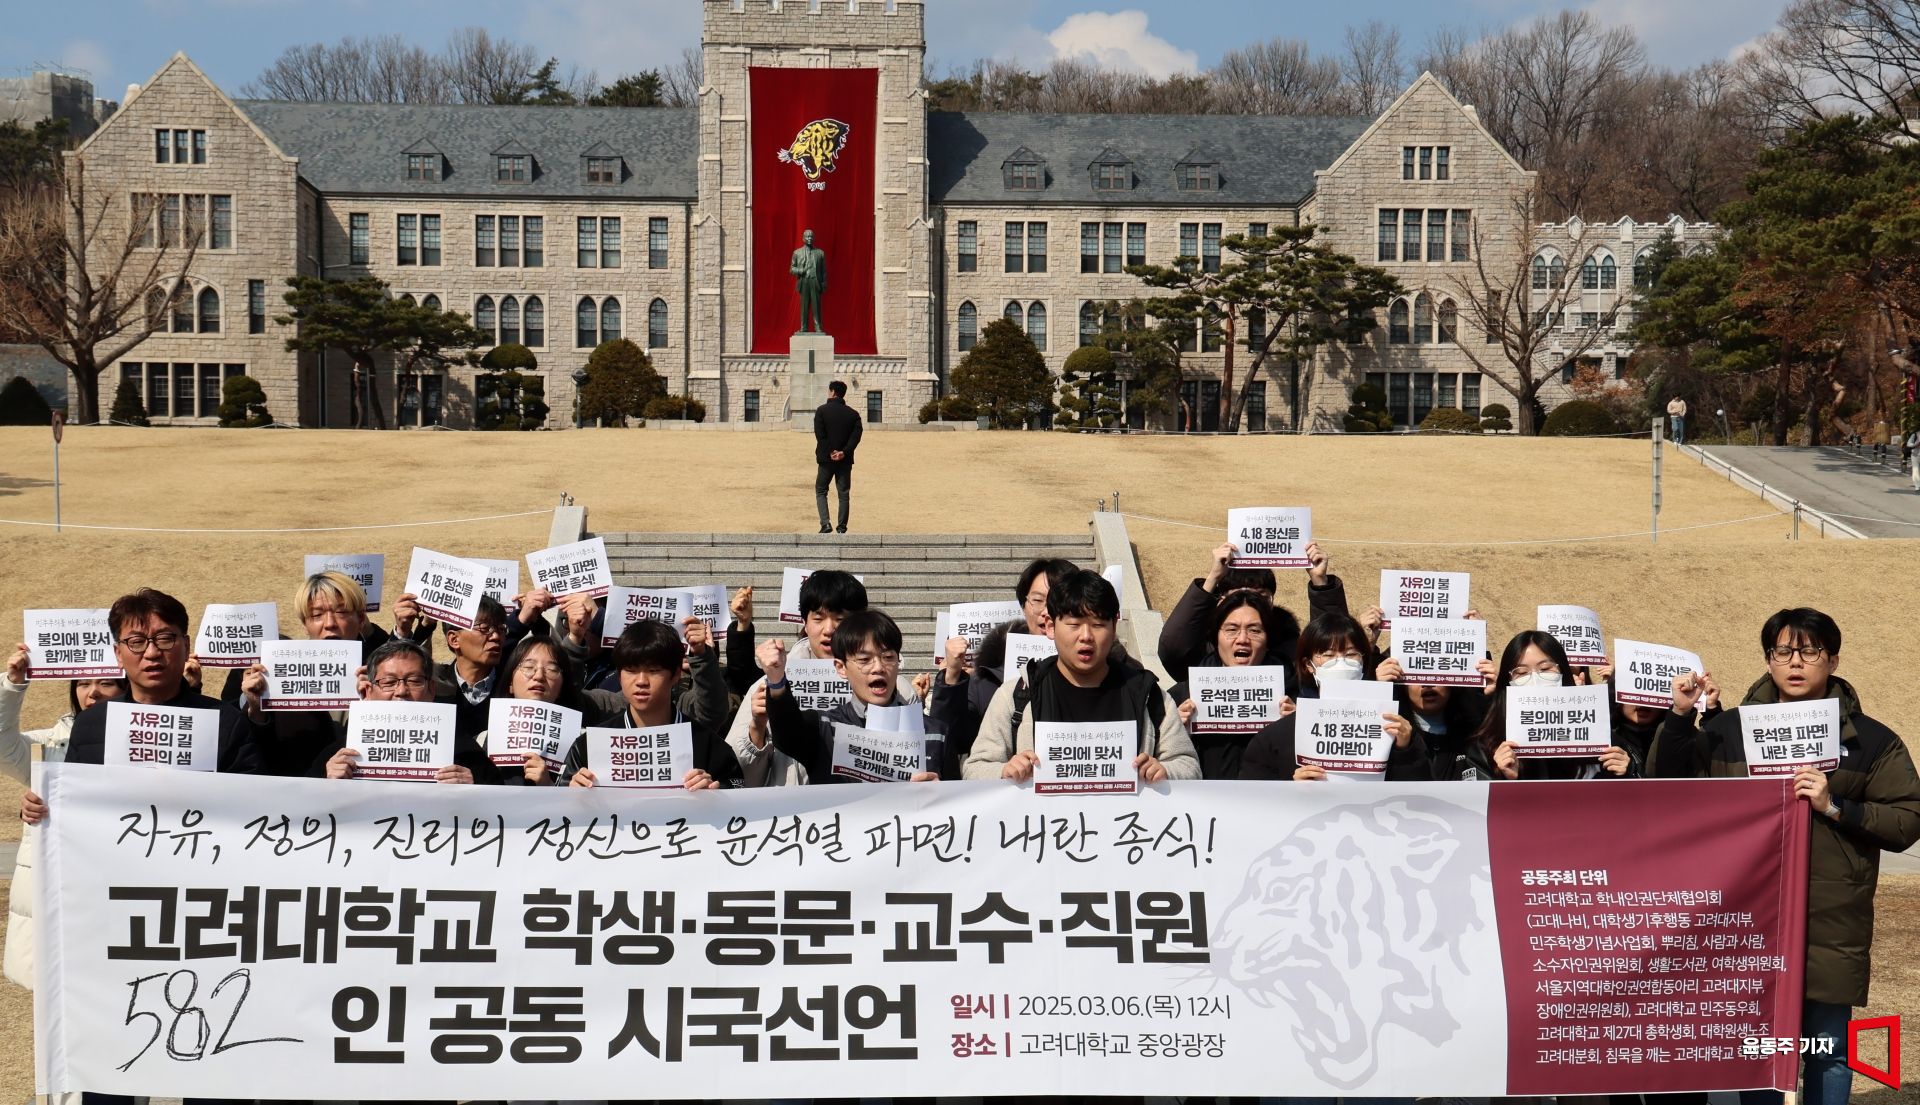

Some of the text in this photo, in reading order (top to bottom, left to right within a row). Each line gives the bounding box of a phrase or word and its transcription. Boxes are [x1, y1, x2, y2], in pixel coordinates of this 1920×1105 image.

[1240, 527, 1300, 539] 4.18 정신을
[1245, 542, 1292, 554] 이어받아
[537, 558, 599, 582] 윤석열 파면!
[420, 571, 473, 597] 4.18 정신을
[485, 577, 507, 589] 맞서
[545, 573, 596, 594] 내란 종식!
[1400, 577, 1450, 590] 자유의 불
[421, 588, 463, 611] 이어받아
[627, 594, 677, 610] 자유의 불
[1399, 591, 1449, 605] 정의의 길
[693, 603, 720, 616] 정신을
[1398, 605, 1449, 619] 진리의 샘
[663, 612, 676, 624] 길
[205, 625, 263, 638] 4.18 정신을
[957, 622, 991, 635] 윤석열
[1548, 625, 1582, 637] 윤석열
[38, 632, 111, 647] 불의에 맞서
[208, 641, 257, 653] 이어받아
[1402, 640, 1474, 655] 윤석열 파면!
[45, 649, 104, 663] 함께할 때
[1408, 657, 1468, 671] 내란 종식!
[274, 663, 347, 677] 불의에 맞서
[1629, 661, 1652, 675] 4.18
[281, 680, 340, 694] 함께할 때
[1634, 677, 1671, 693] 이어받
[1200, 688, 1273, 702] 윤석열 파면!
[508, 705, 563, 725] 자유의 불
[1208, 704, 1267, 718] 내란 종식!
[1520, 709, 1596, 725] 불의에 맞서
[129, 712, 193, 730] 자유의 불
[361, 729, 439, 745] 불의에 맞서
[507, 720, 561, 740] 정의의 길
[1310, 723, 1382, 739] 4.18 정신을
[1528, 727, 1589, 742] 함께할 때
[1752, 724, 1828, 743] 윤석열 파면!
[129, 730, 192, 748] 정의의 길
[506, 736, 559, 755] 진리의 샘
[610, 732, 670, 749] 자유의 불
[128, 747, 192, 765] 진리의 샘
[368, 747, 431, 763] 함께할 때
[848, 744, 919, 769] 불의에 맞서
[1048, 746, 1123, 760] 불의에 맞서
[1316, 741, 1373, 756] 이어받아
[1761, 742, 1823, 760] 내란 종식!
[611, 750, 671, 765] 정의의 길
[611, 767, 672, 782] 진리의 샘
[854, 757, 895, 777] 함께할
[1055, 763, 1116, 778] 함께할 때
[117, 804, 1217, 869] 자유, 정의, 진리의 정신으로 윤석열 파면! 내란 종식!
[1521, 869, 1608, 886] 공동주최 단위
[1524, 890, 1722, 907] 고려대학교 학내인권단체협의회
[107, 886, 497, 965] 고려대학교
[1526, 912, 1755, 929] (고대나비, 대학생기후행동 고려대지부,
[1529, 933, 1766, 951] 민주학생기념사업회, 뿌리침, 사람과 사람,
[1532, 955, 1787, 974] 소수자인권위원회, 생활도서관, 여학생위원회,
[1535, 978, 1765, 996] 서울지역대학인권연합동아리 고려대지부,
[950, 994, 1231, 1020] 일시 2025.03.06.(목) 12시
[1536, 1000, 1761, 1019] 장애인권위원회), 고려대학교 민주동우회,
[116, 968, 918, 1073] 582 인 공동 시국선언
[1536, 1022, 1769, 1042] 고려대학교 제27대 총학생회, 대학원생노조
[950, 1032, 1226, 1058] 장소 고려대학교 중앙광장
[1535, 1047, 1602, 1065] 고려대분회,
[1605, 1047, 1643, 1064] 침묵을
[1645, 1047, 1671, 1063] 깨는
[1673, 1046, 1734, 1062] 고려대학교
